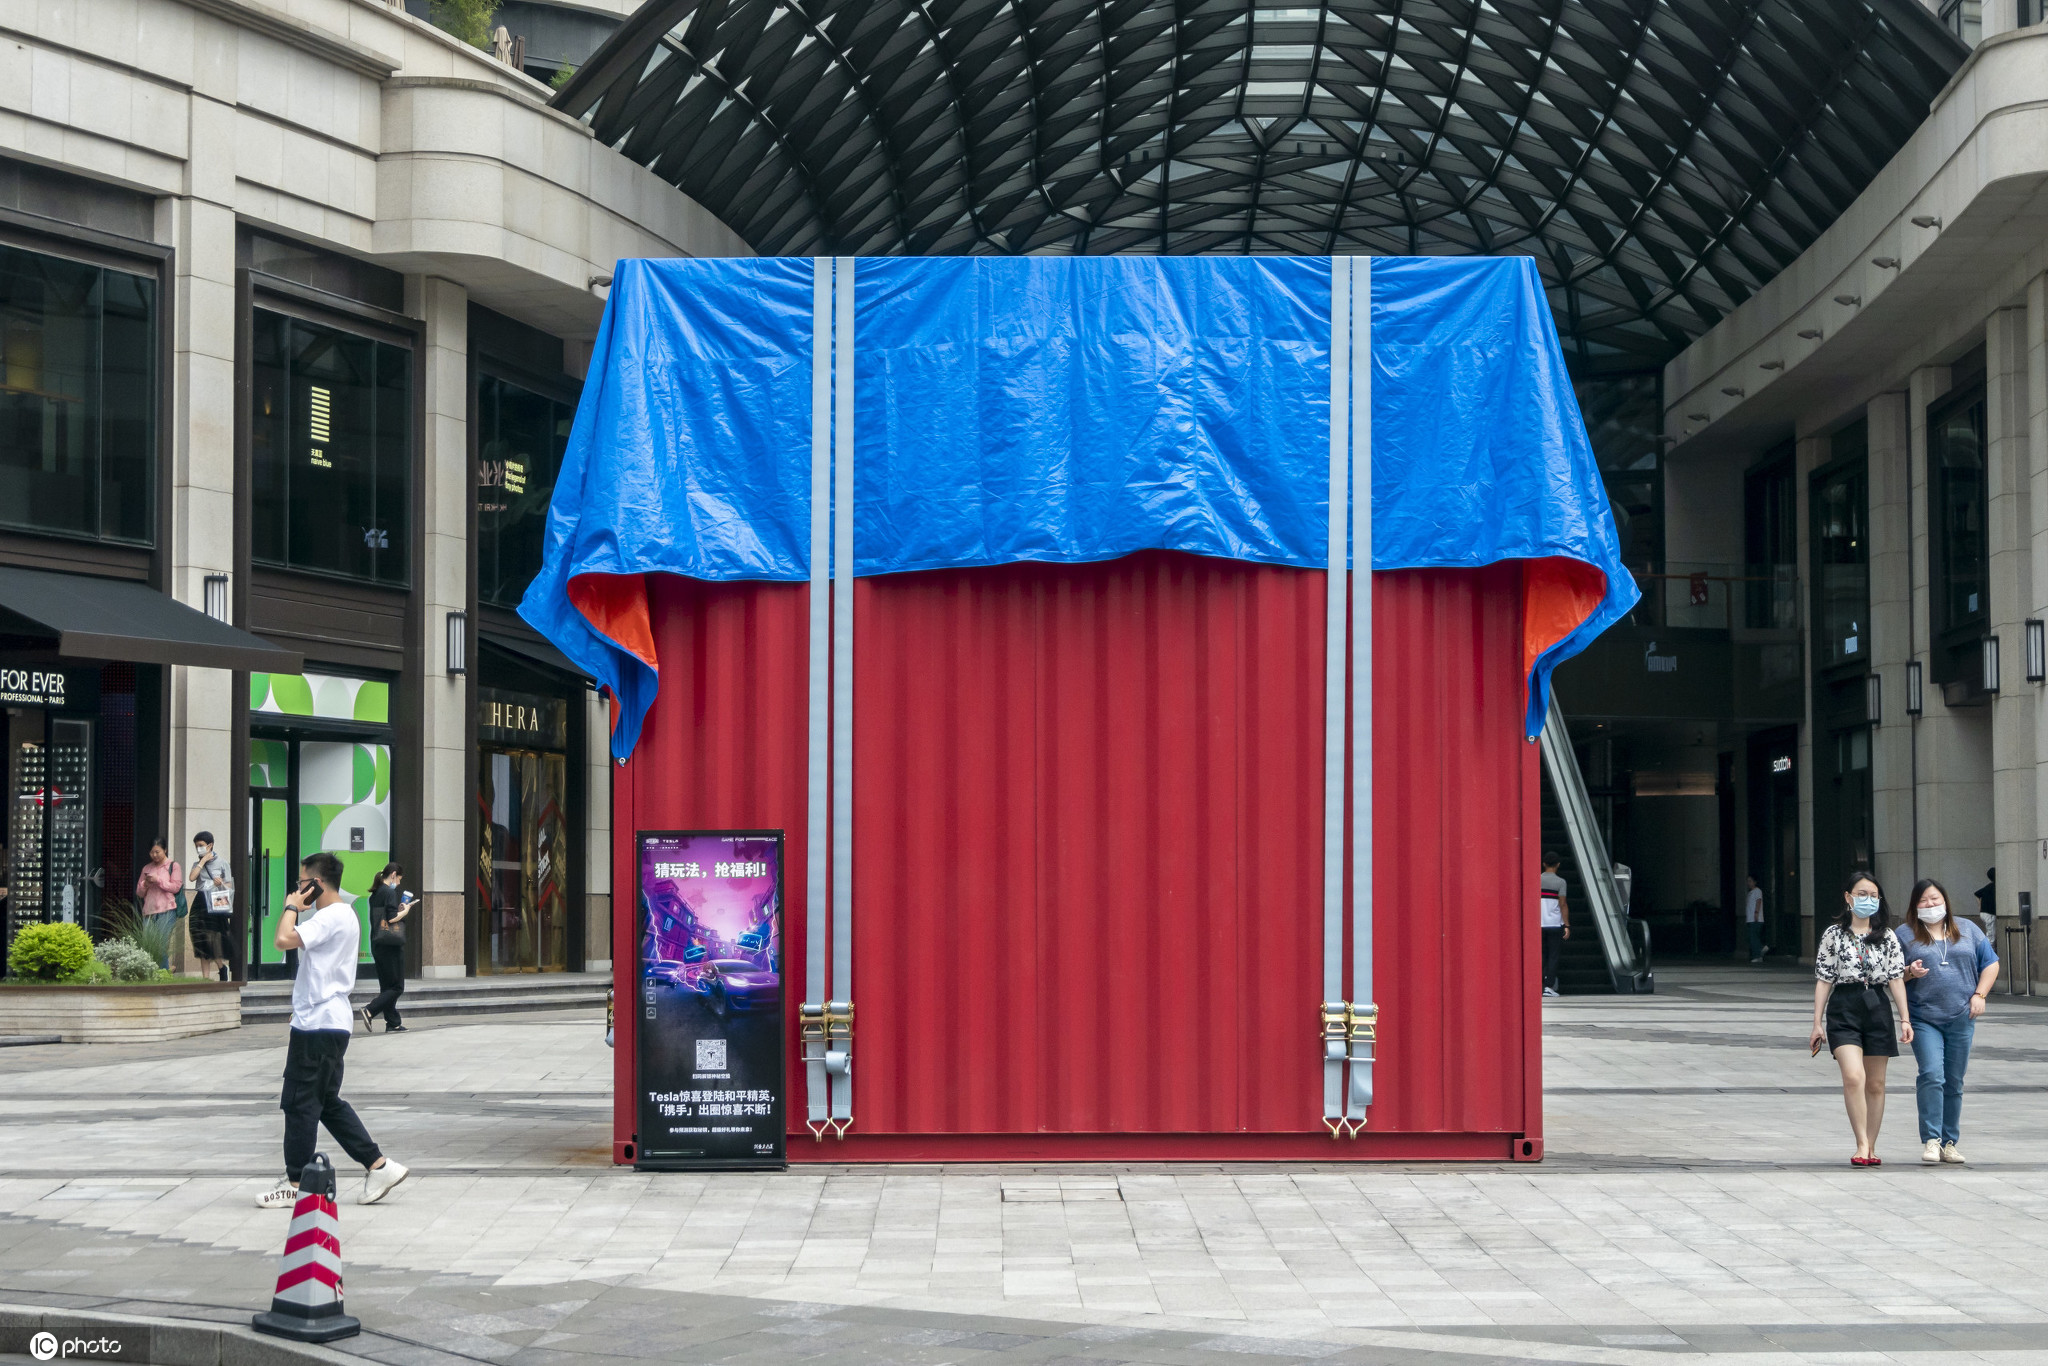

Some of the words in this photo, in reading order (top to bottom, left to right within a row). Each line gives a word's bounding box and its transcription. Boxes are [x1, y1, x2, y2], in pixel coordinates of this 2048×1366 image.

[0, 668, 29, 691] FOR
[32, 671, 65, 694] EVER
[0, 692, 44, 704] PROFESSIONAL
[48, 695, 65, 705] PARIS
[492, 702, 539, 732] HERA
[263, 1190, 298, 1203] BOSTON
